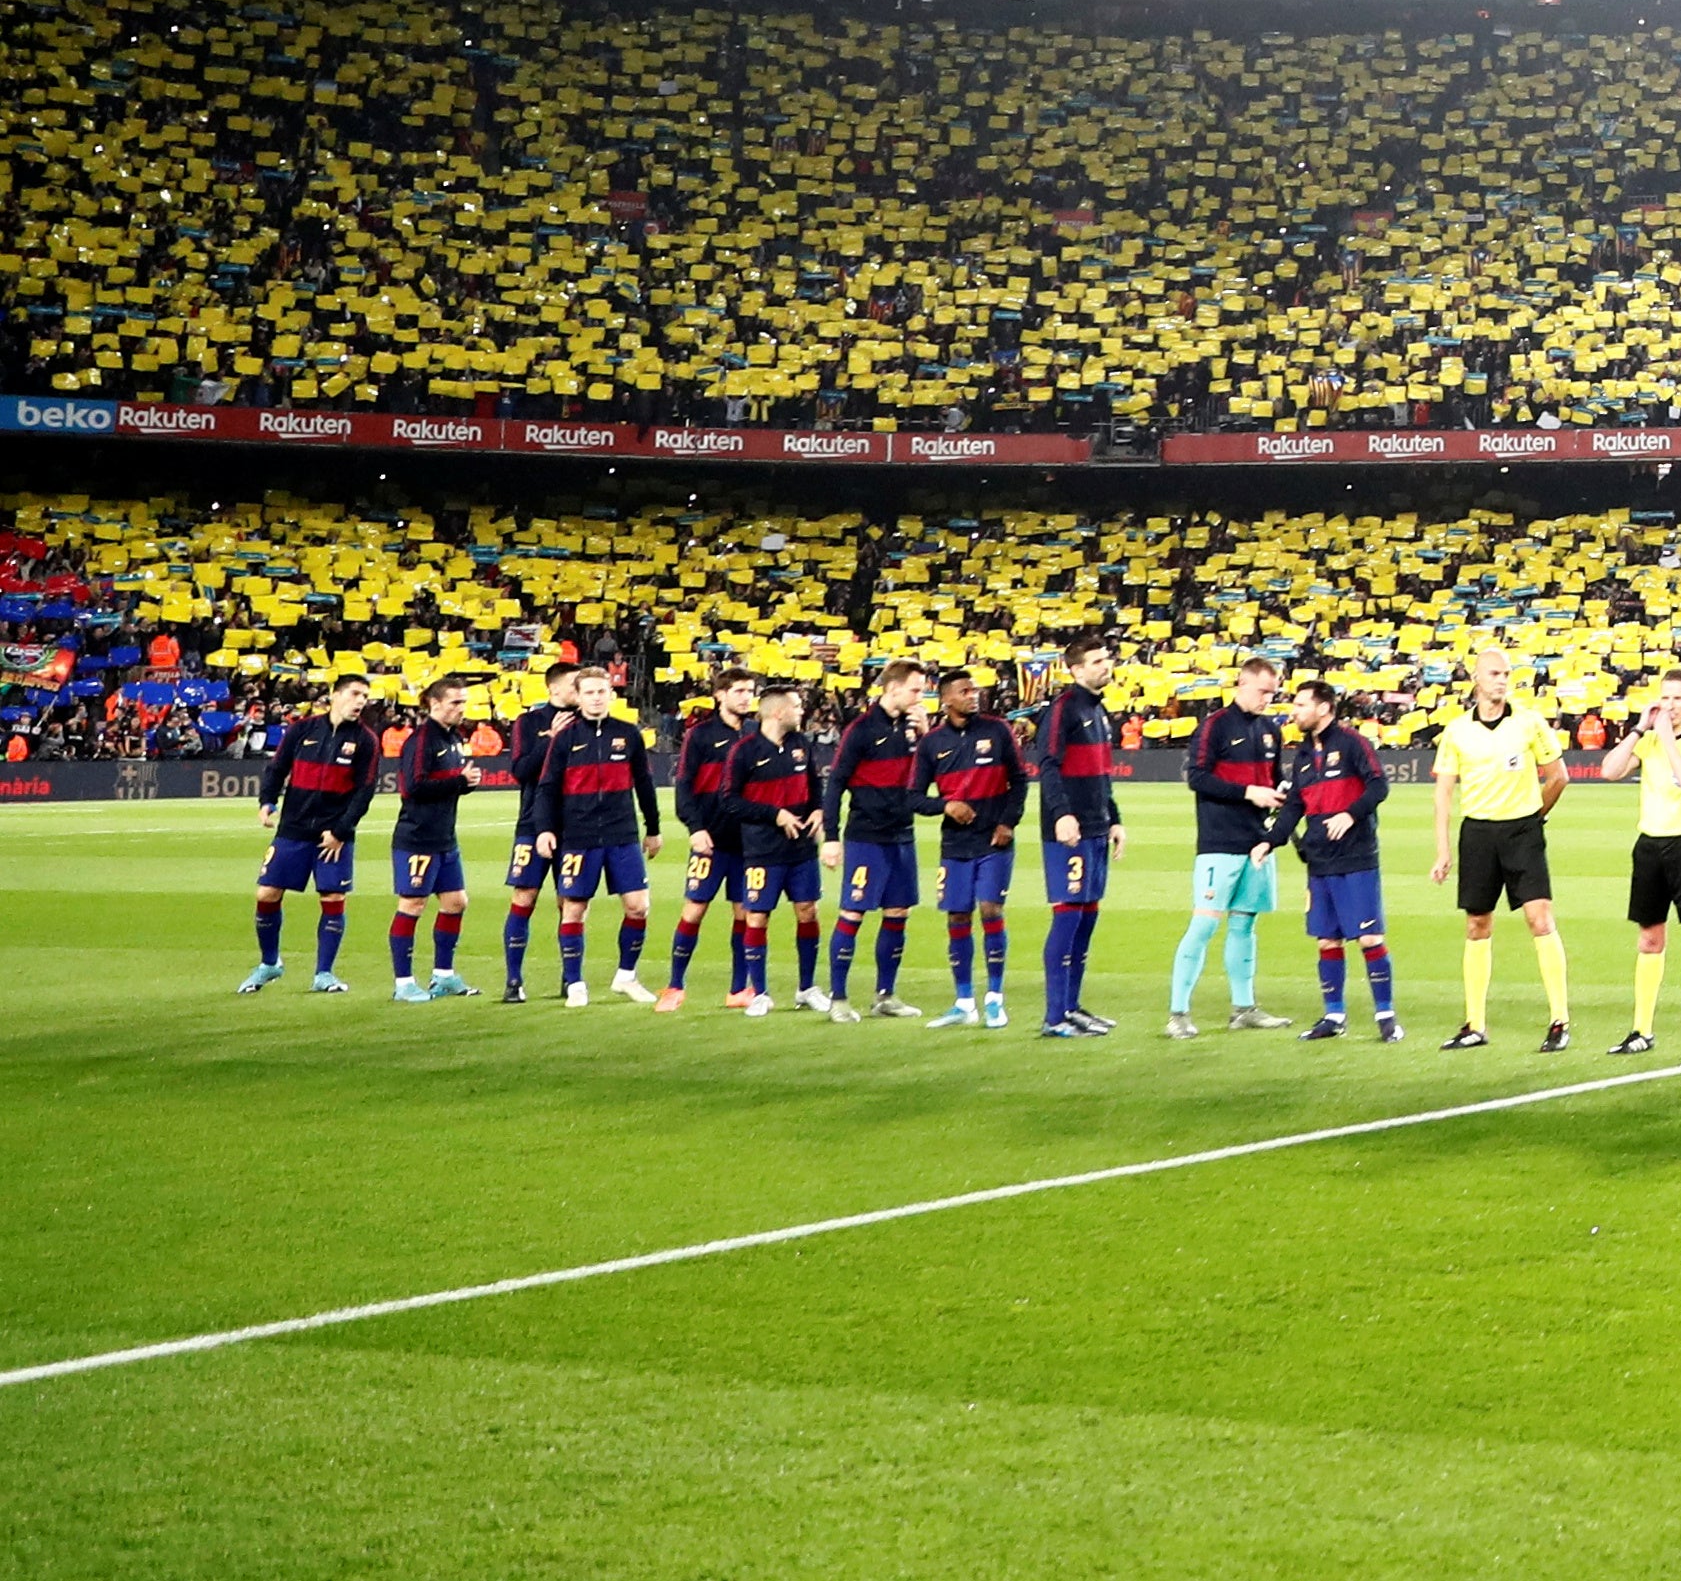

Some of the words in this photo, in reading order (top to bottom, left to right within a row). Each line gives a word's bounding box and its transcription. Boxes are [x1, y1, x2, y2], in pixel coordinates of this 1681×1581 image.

[17, 401, 110, 430] beko
[119, 406, 215, 430] Rakuten
[259, 412, 351, 435] Rakuten
[393, 419, 481, 441] Rakuten
[525, 424, 614, 446] Rakuten
[655, 430, 743, 451] Rakuten
[1593, 432, 1670, 450] Rakuten
[783, 434, 869, 453] Rakuten
[912, 437, 994, 456] Rakuten
[1258, 436, 1333, 455] Rakuten
[1368, 434, 1444, 452] Rakuten
[1479, 433, 1556, 451] Rakuten
[201, 769, 260, 797] Bon
[408, 854, 431, 876] 17
[513, 844, 532, 866] 15
[561, 853, 583, 876] 21
[688, 855, 711, 879] 20
[852, 866, 867, 888] 4
[1068, 856, 1083, 881] 3
[1207, 866, 1215, 886] 1
[745, 867, 766, 890] 18
